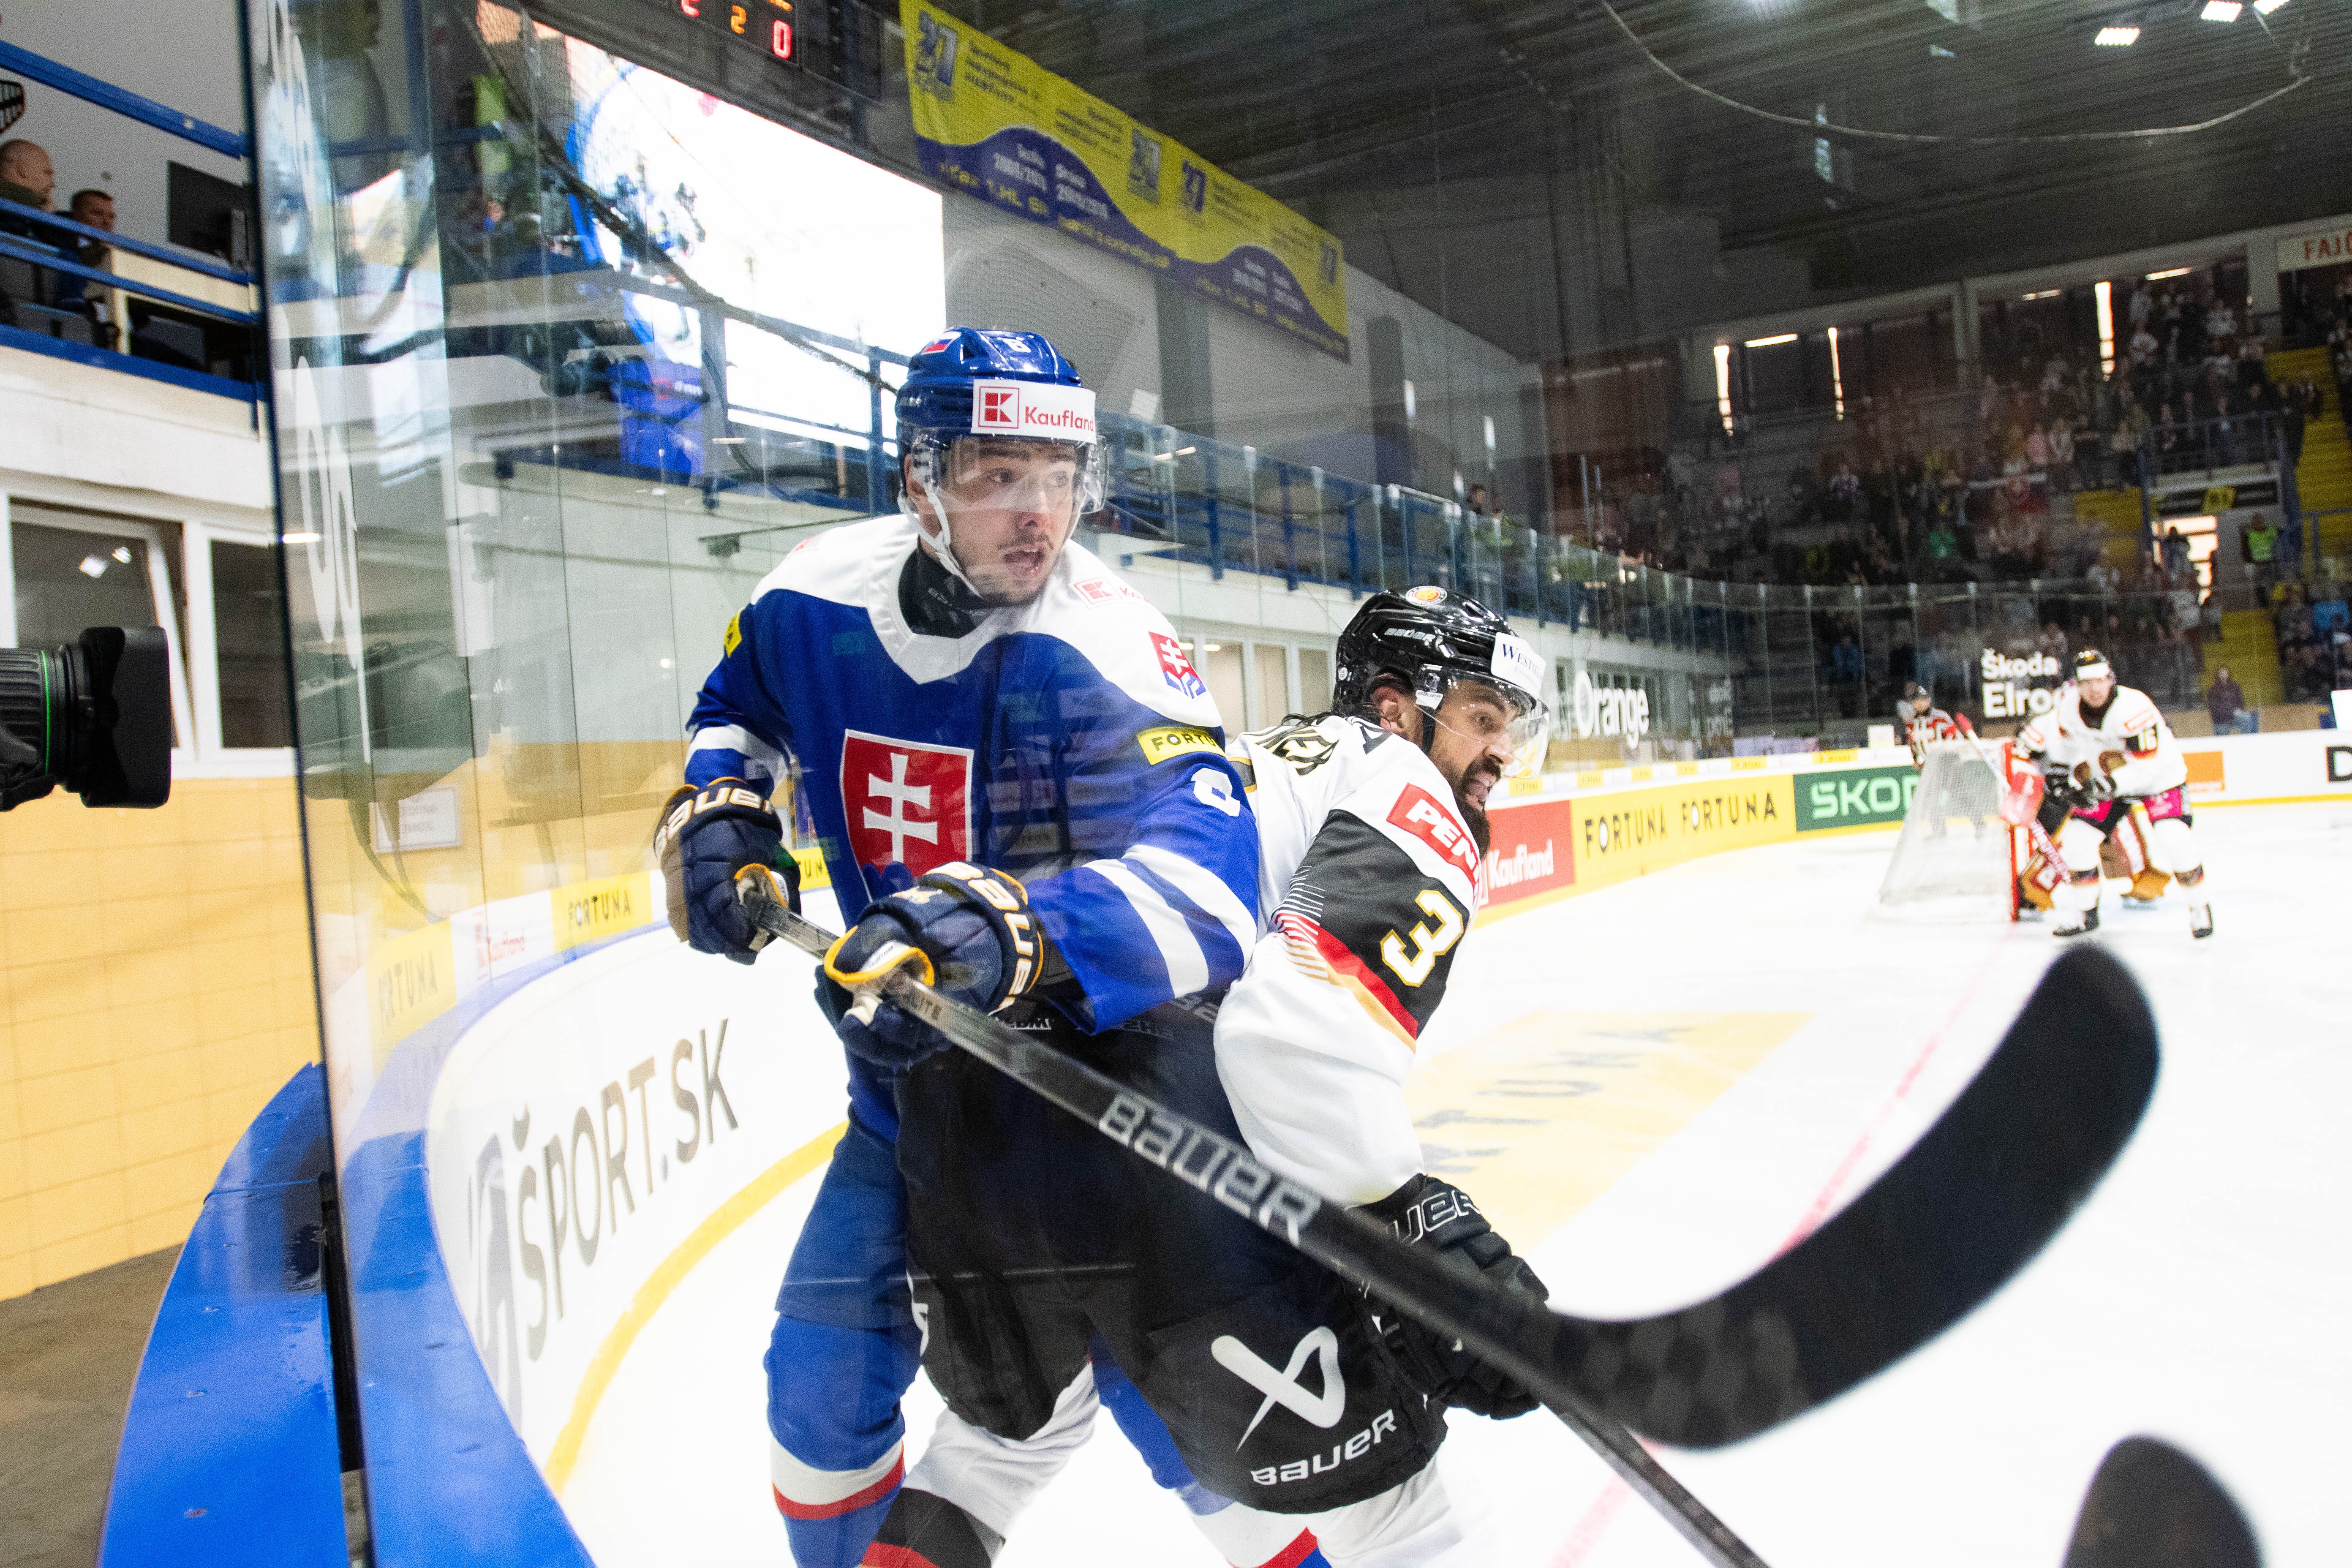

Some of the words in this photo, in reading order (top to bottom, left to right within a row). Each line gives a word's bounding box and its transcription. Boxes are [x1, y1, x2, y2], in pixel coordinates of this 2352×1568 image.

[730, 5, 746, 34] 2
[772, 19, 792, 59] 0
[1024, 405, 1094, 433] Kaufland
[1384, 628, 1436, 645] BAUER
[1980, 648, 2058, 678] Škoda
[1575, 670, 1649, 749] Orange
[1584, 806, 1668, 858] FORTUNA
[1682, 791, 1778, 832] FORTUNA
[1489, 839, 1554, 888] Kaufland
[568, 888, 631, 929] FORTUNA
[1380, 889, 1465, 988] 3
[1098, 1089, 1322, 1246] BAUER
[1392, 1189, 1481, 1245] UER
[1250, 1408, 1397, 1486] BAUER
